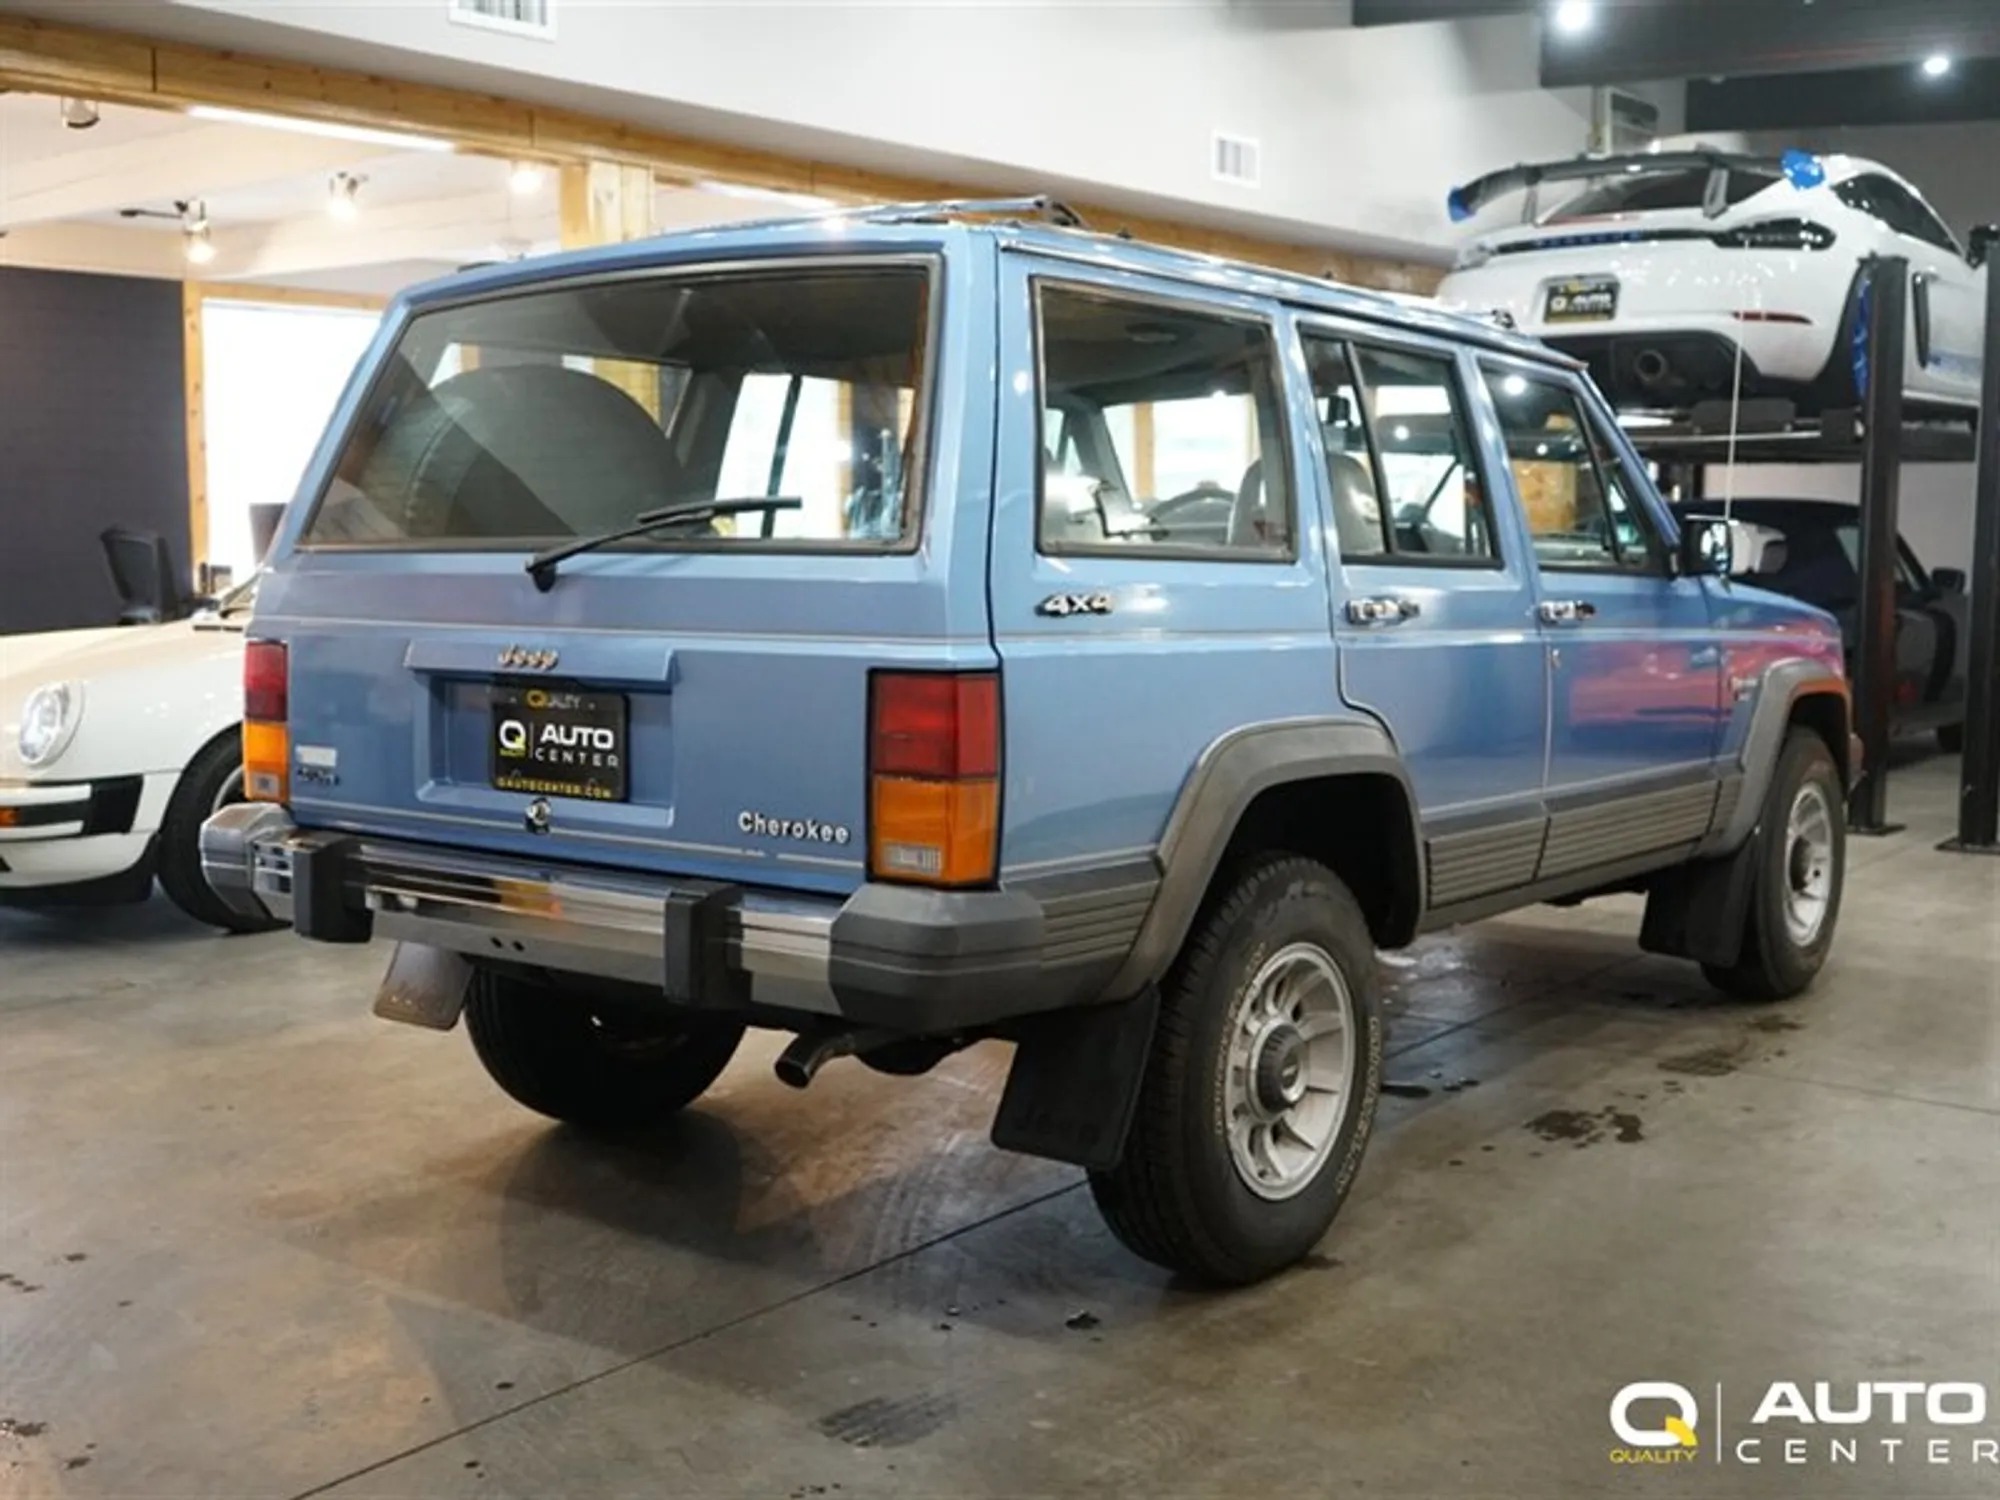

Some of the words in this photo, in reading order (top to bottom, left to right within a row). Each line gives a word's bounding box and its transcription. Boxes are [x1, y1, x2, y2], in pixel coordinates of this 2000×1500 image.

[540, 723, 615, 750] AUTO
[535, 747, 619, 768] CENTER
[738, 810, 850, 844] Cherokee
